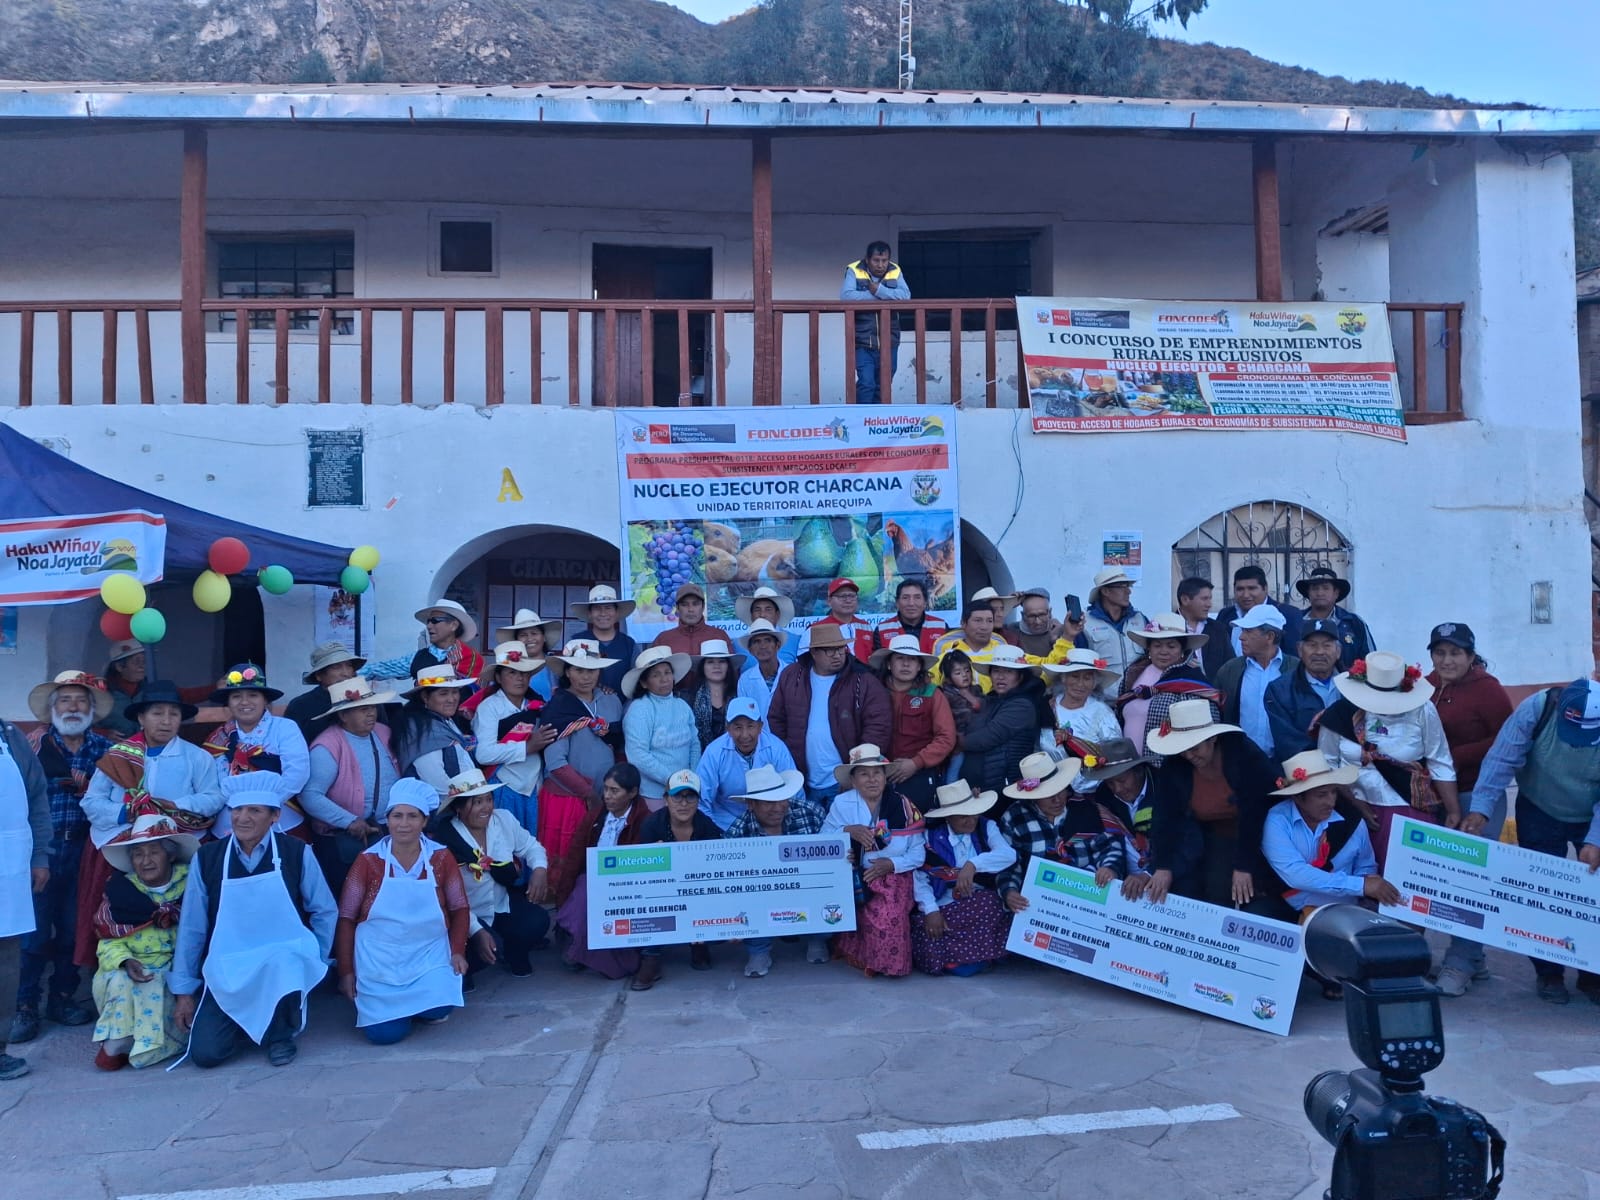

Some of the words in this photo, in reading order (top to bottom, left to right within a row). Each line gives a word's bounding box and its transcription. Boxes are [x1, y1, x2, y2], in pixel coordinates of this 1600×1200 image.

[1158, 314, 1217, 322] FONCODES
[1048, 332, 1056, 343] I
[1060, 333, 1155, 348] CONCURSO
[1160, 337, 1184, 349] DE
[1190, 336, 1362, 350] EMPRENDIMIENTOS
[1112, 348, 1193, 361] RURALES
[1199, 350, 1302, 362] INCLUSIVOS
[1159, 361, 1227, 373] EJECUTOR
[1237, 363, 1311, 373] CHARCANA
[1214, 406, 1242, 414] FECHA
[1350, 408, 1397, 417] CHARCANA
[747, 427, 833, 439] FONCODES
[1037, 420, 1080, 430] PROYECTO:
[1080, 420, 1111, 429] ACCESO
[1112, 420, 1123, 429] DE
[1124, 419, 1161, 429] HOGARES
[1161, 418, 1197, 428] RURALES
[1197, 418, 1214, 427] CON
[1215, 415, 1260, 427] ECONOMÍAS
[1260, 418, 1271, 427] DE
[1272, 417, 1327, 428] SUBSISTENCIA
[1328, 418, 1335, 428] A
[1335, 418, 1374, 433] MERCADOS
[1374, 424, 1402, 437] LOCALES
[634, 456, 678, 465] PROGRAMA
[678, 455, 734, 464] PRESUPUESTAL
[756, 454, 785, 462] ACCESO
[787, 453, 798, 461] DE
[798, 452, 833, 461] HOGARES
[834, 451, 867, 460] RURALES
[868, 450, 885, 458] CON
[886, 447, 931, 457] ECONOMÍAS
[932, 447, 941, 455] DE
[722, 464, 774, 474] SUBSISTENCIA
[782, 463, 824, 472] MERCADOS
[825, 462, 857, 470] LOCALES
[497, 467, 524, 502] A
[634, 483, 705, 498] NUCLEO
[709, 480, 800, 497] EJECUTOR
[804, 476, 903, 494] CHARCANA
[696, 502, 741, 512] UNIDAD
[743, 500, 814, 511] TERRITORIAL
[816, 498, 873, 509] AREQUIPA
[783, 847, 793, 858] S/
[795, 845, 840, 860] 13,000.00
[1426, 835, 1479, 857] Interbank
[618, 855, 664, 867] Interbank
[705, 852, 747, 862] 27/08/2025
[684, 871, 712, 880] GRUPO
[714, 870, 724, 878] DE
[726, 868, 760, 878] INTERÉS
[761, 867, 800, 876] GANADOR
[1529, 864, 1581, 884] 27/08/2025
[677, 888, 705, 897] TRECE
[707, 886, 722, 895] MIL
[724, 885, 743, 893] CON
[774, 882, 801, 890] SOLES
[1055, 874, 1102, 896] Interbank
[1501, 876, 1535, 890] GRUPO
[1537, 886, 1550, 895] DE
[1553, 889, 1597, 906] INTERÉS
[1402, 881, 1439, 897] CHEQUE
[1440, 891, 1452, 900] DE
[1453, 895, 1500, 914] GERENCIA
[1490, 888, 1524, 905] TRECE
[1527, 898, 1545, 910] MIL
[1549, 904, 1572, 917] CON
[604, 907, 636, 917] CHEQUE
[637, 906, 647, 914] DE
[648, 904, 688, 914] GERENCIA
[1142, 901, 1187, 920] 27/08/2025
[692, 917, 740, 927] FONCODES
[1029, 918, 1060, 934] CHEQUE
[1060, 927, 1070, 936] DE
[1071, 930, 1110, 949] GERENCIA
[1116, 913, 1145, 927] GRUPO
[1147, 921, 1158, 931] DE
[1160, 924, 1196, 941] INTERÉS
[1198, 935, 1240, 953] GANADOR
[1227, 921, 1237, 934] S/
[1241, 924, 1294, 949] 13,000.00
[1504, 926, 1566, 947] FONCODES
[1104, 925, 1133, 940] TRECE
[1135, 934, 1150, 945] MIL
[1153, 939, 1173, 951] CON
[1206, 954, 1237, 969] SOLES
[1110, 960, 1160, 980] FONCODES
